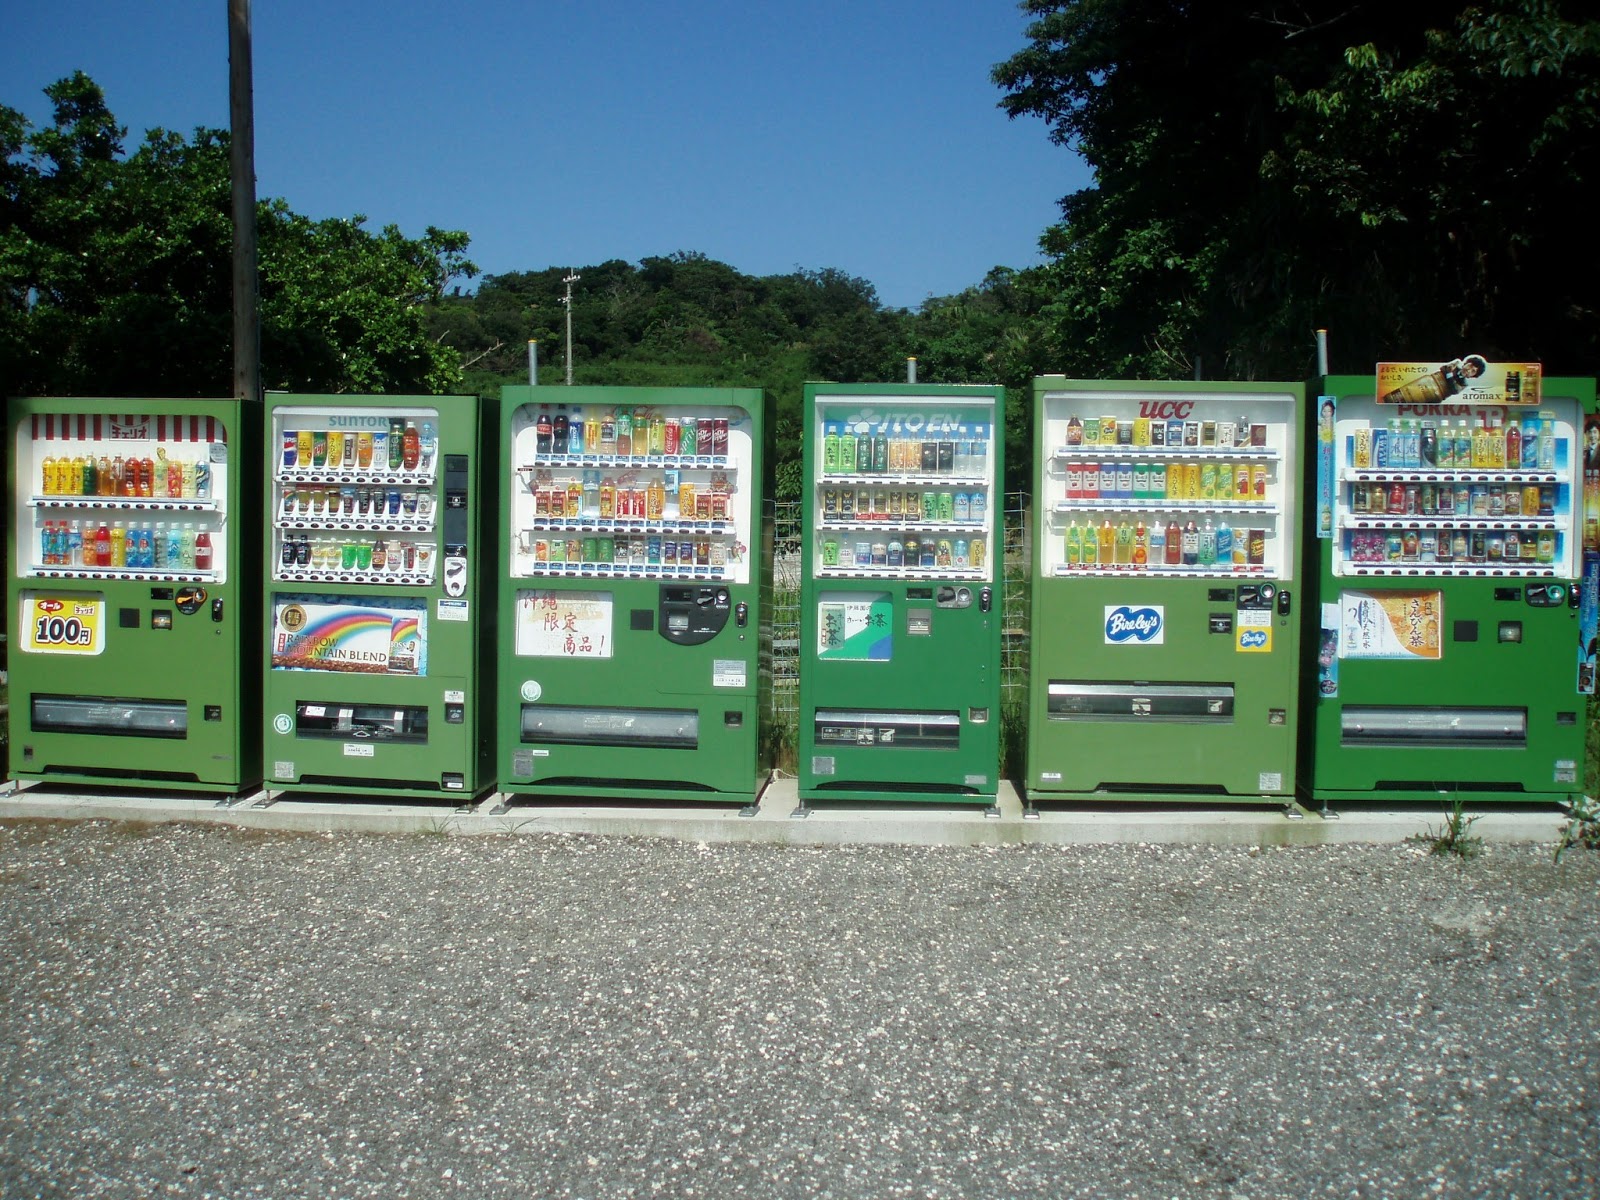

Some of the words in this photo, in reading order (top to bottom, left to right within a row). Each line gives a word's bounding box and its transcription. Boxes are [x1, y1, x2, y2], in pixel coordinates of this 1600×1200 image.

[1462, 392, 1501, 400] aromax
[1138, 401, 1194, 420] UCC
[329, 416, 390, 428] SUNTOR
[927, 413, 962, 430] EN
[40, 601, 61, 610] オール
[543, 612, 578, 633] 限定
[1108, 612, 1158, 634] Bireley's
[1410, 599, 1424, 648] さんぴん茶
[287, 634, 339, 648] RAINBOW
[349, 651, 388, 663] BLEND
